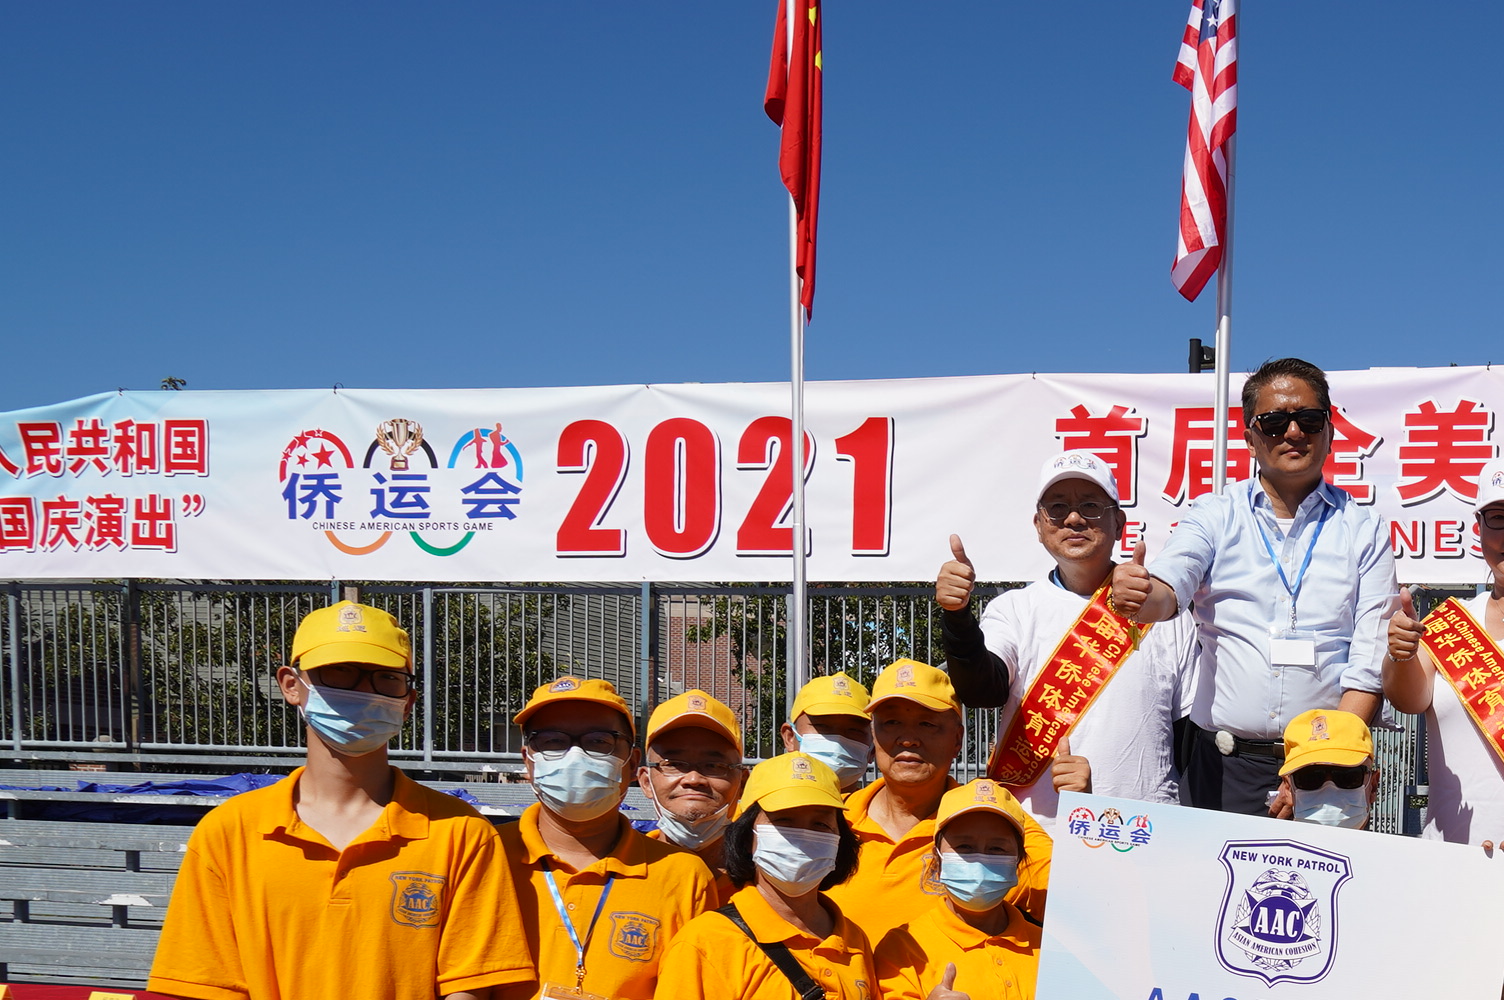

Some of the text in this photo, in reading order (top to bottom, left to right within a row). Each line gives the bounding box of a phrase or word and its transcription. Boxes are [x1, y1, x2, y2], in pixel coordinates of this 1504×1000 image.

[281, 471, 523, 520] 侨运会
[556, 415, 894, 559] 2021
[312, 520, 494, 532] CHINESE AMERICAN SPORTS GAME
[1446, 609, 1460, 627] 1st
[1453, 620, 1487, 654] Chinese
[1081, 642, 1122, 689] Chinese
[1041, 684, 1089, 746] American
[1068, 819, 1152, 845] 侨运会
[1232, 849, 1341, 874] NEW YORK PATROL
[408, 898, 429, 910] AAC
[1253, 905, 1301, 938] AAC
[625, 934, 644, 946] AAC
[1232, 931, 1318, 957] ASIAN AMERICAN COHESION
